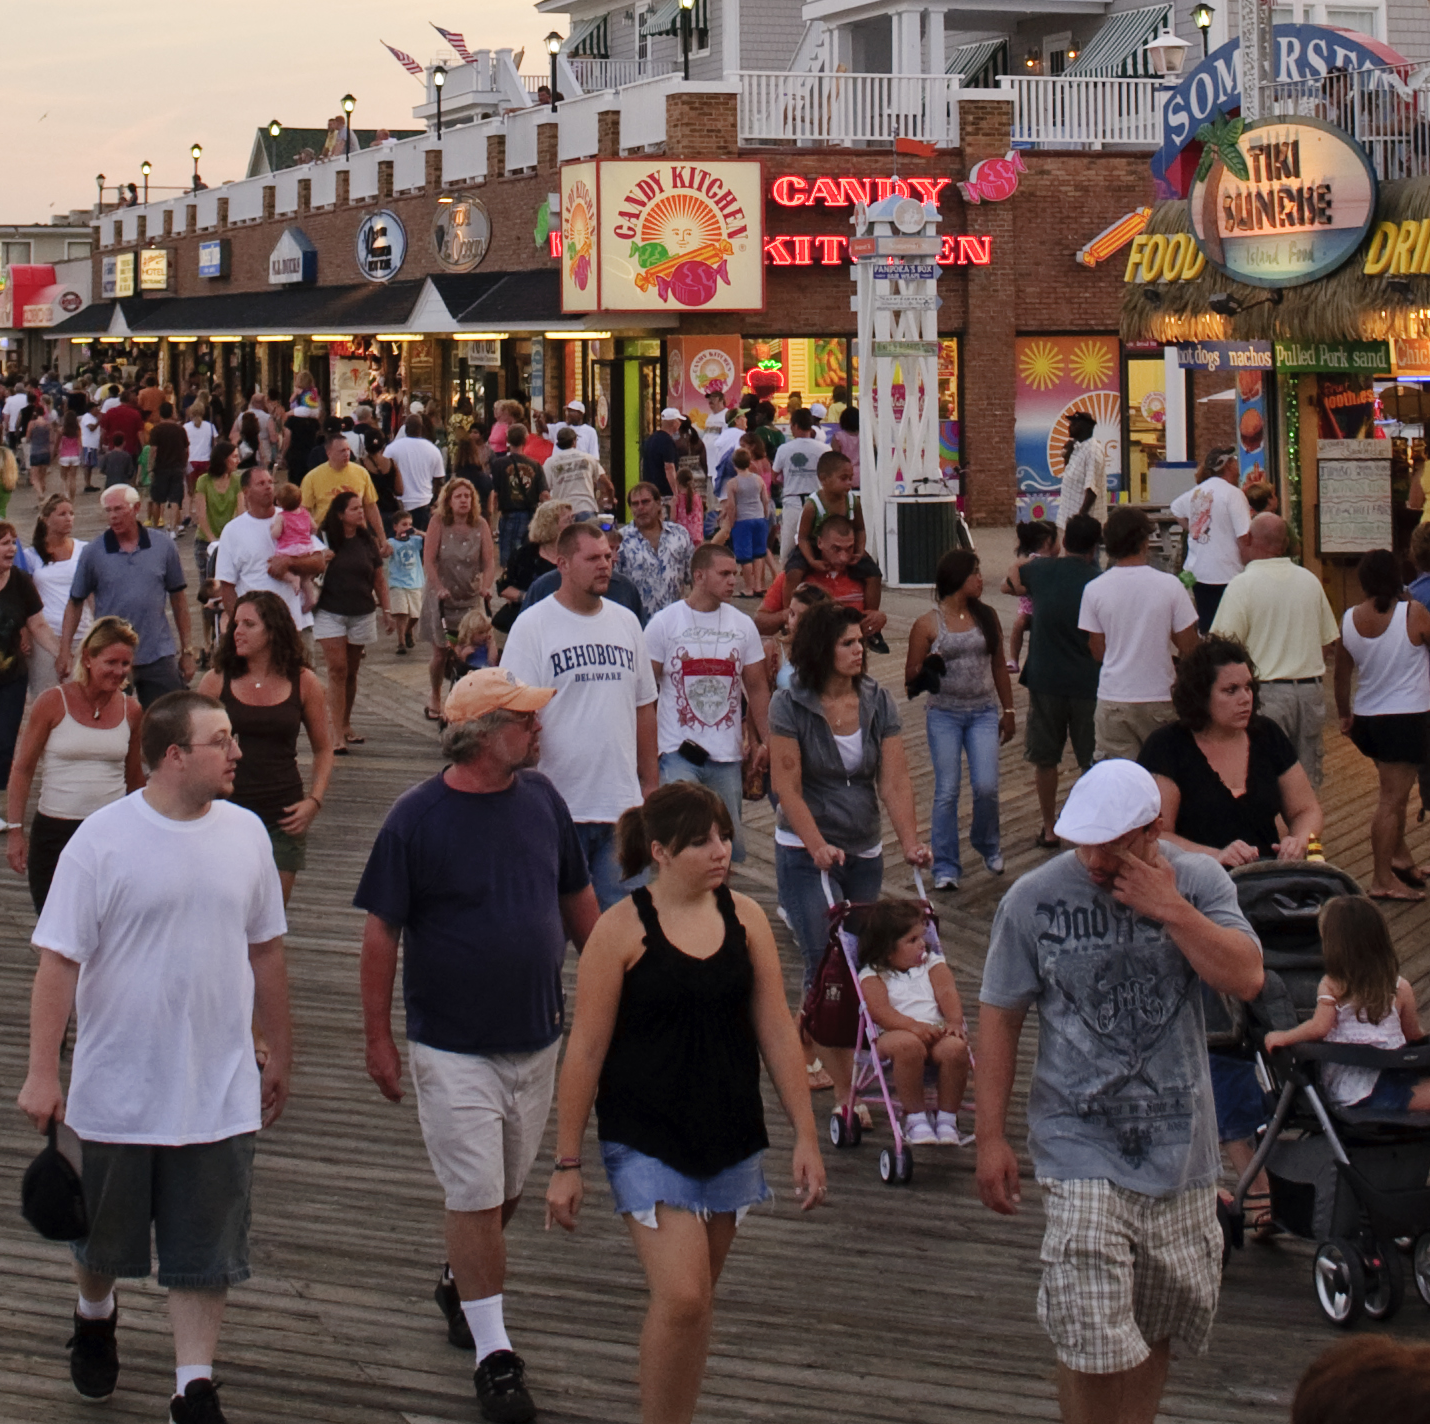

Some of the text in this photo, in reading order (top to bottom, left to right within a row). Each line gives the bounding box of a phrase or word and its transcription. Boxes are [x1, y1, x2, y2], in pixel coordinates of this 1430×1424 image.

[1247, 138, 1300, 183] TIKI
[614, 166, 748, 240] CANDY KITCHEN
[773, 176, 952, 207] CANDY
[1224, 183, 1332, 232] SUNRISE
[763, 235, 993, 265] KITEN
[1124, 232, 1207, 283] FOOD
[1246, 241, 1315, 265] Island Food
[1195, 345, 1220, 371] dogs
[1228, 345, 1271, 366] nachos
[1277, 343, 1386, 368] Pulled Pork sand
[551, 644, 635, 677] REHOBOTH
[574, 672, 622, 683] DELAWARE
